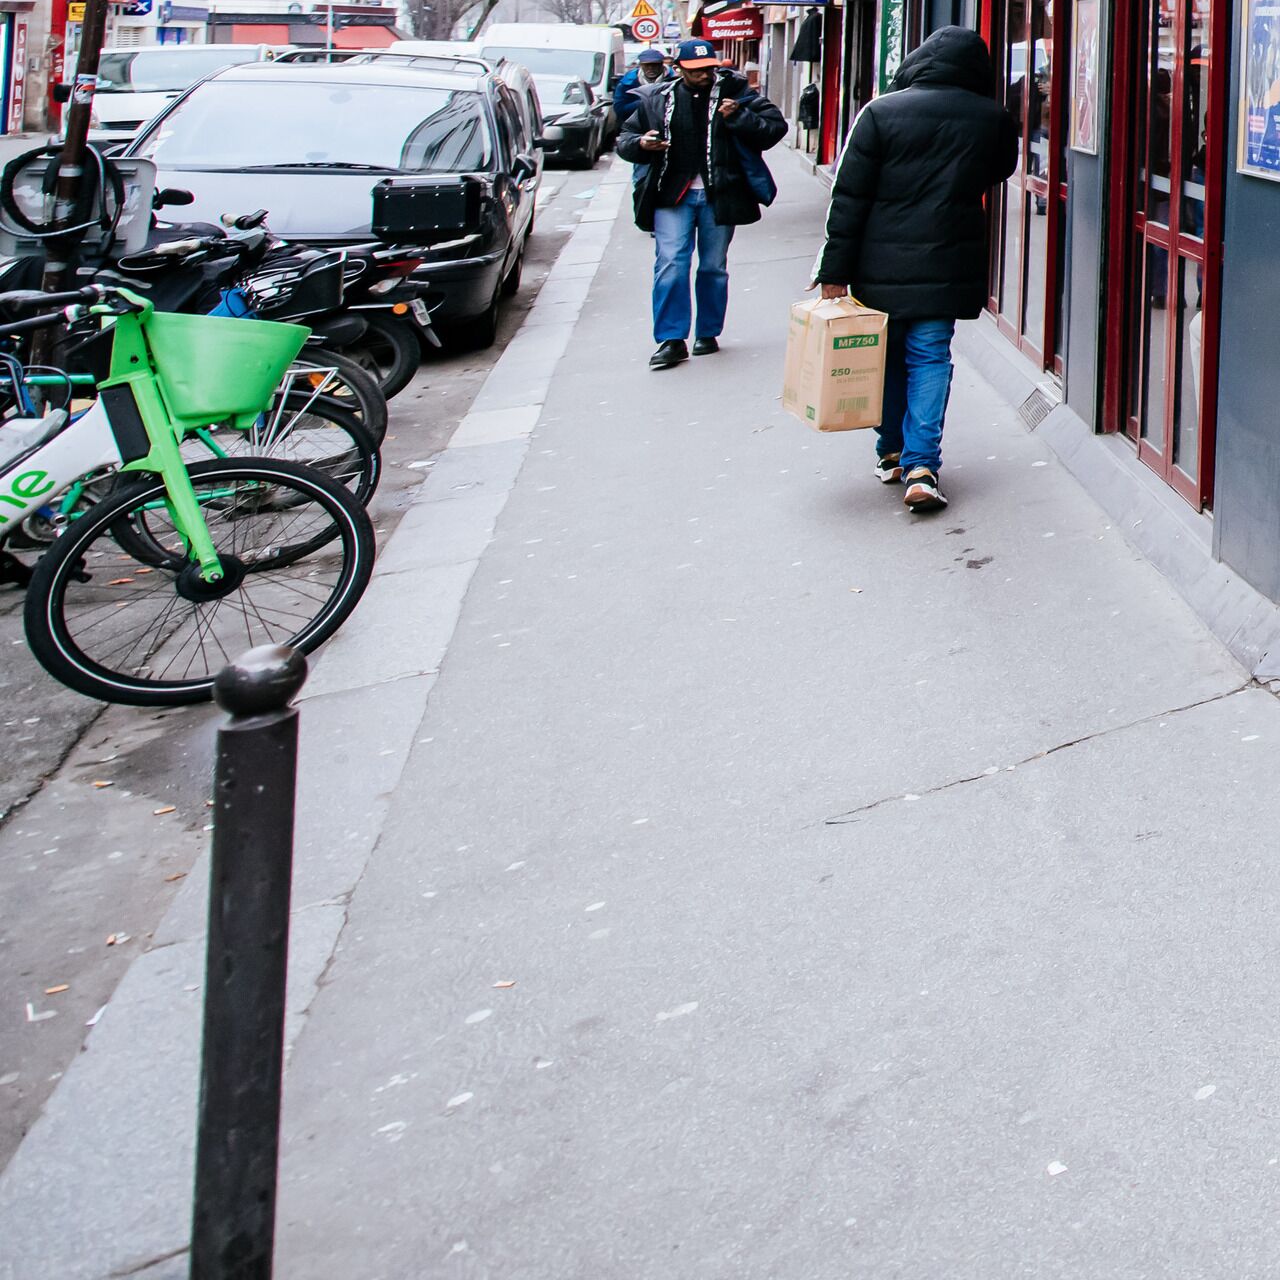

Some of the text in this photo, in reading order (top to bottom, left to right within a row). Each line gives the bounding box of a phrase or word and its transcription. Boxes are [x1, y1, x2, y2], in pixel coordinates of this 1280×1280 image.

[708, 18, 753, 28] Boucherie
[640, 24, 654, 34] 30
[711, 28, 754, 39] Rôtisserie
[13, 29, 27, 119] STORE
[838, 336, 875, 348] MF750
[831, 368, 851, 377] 250
